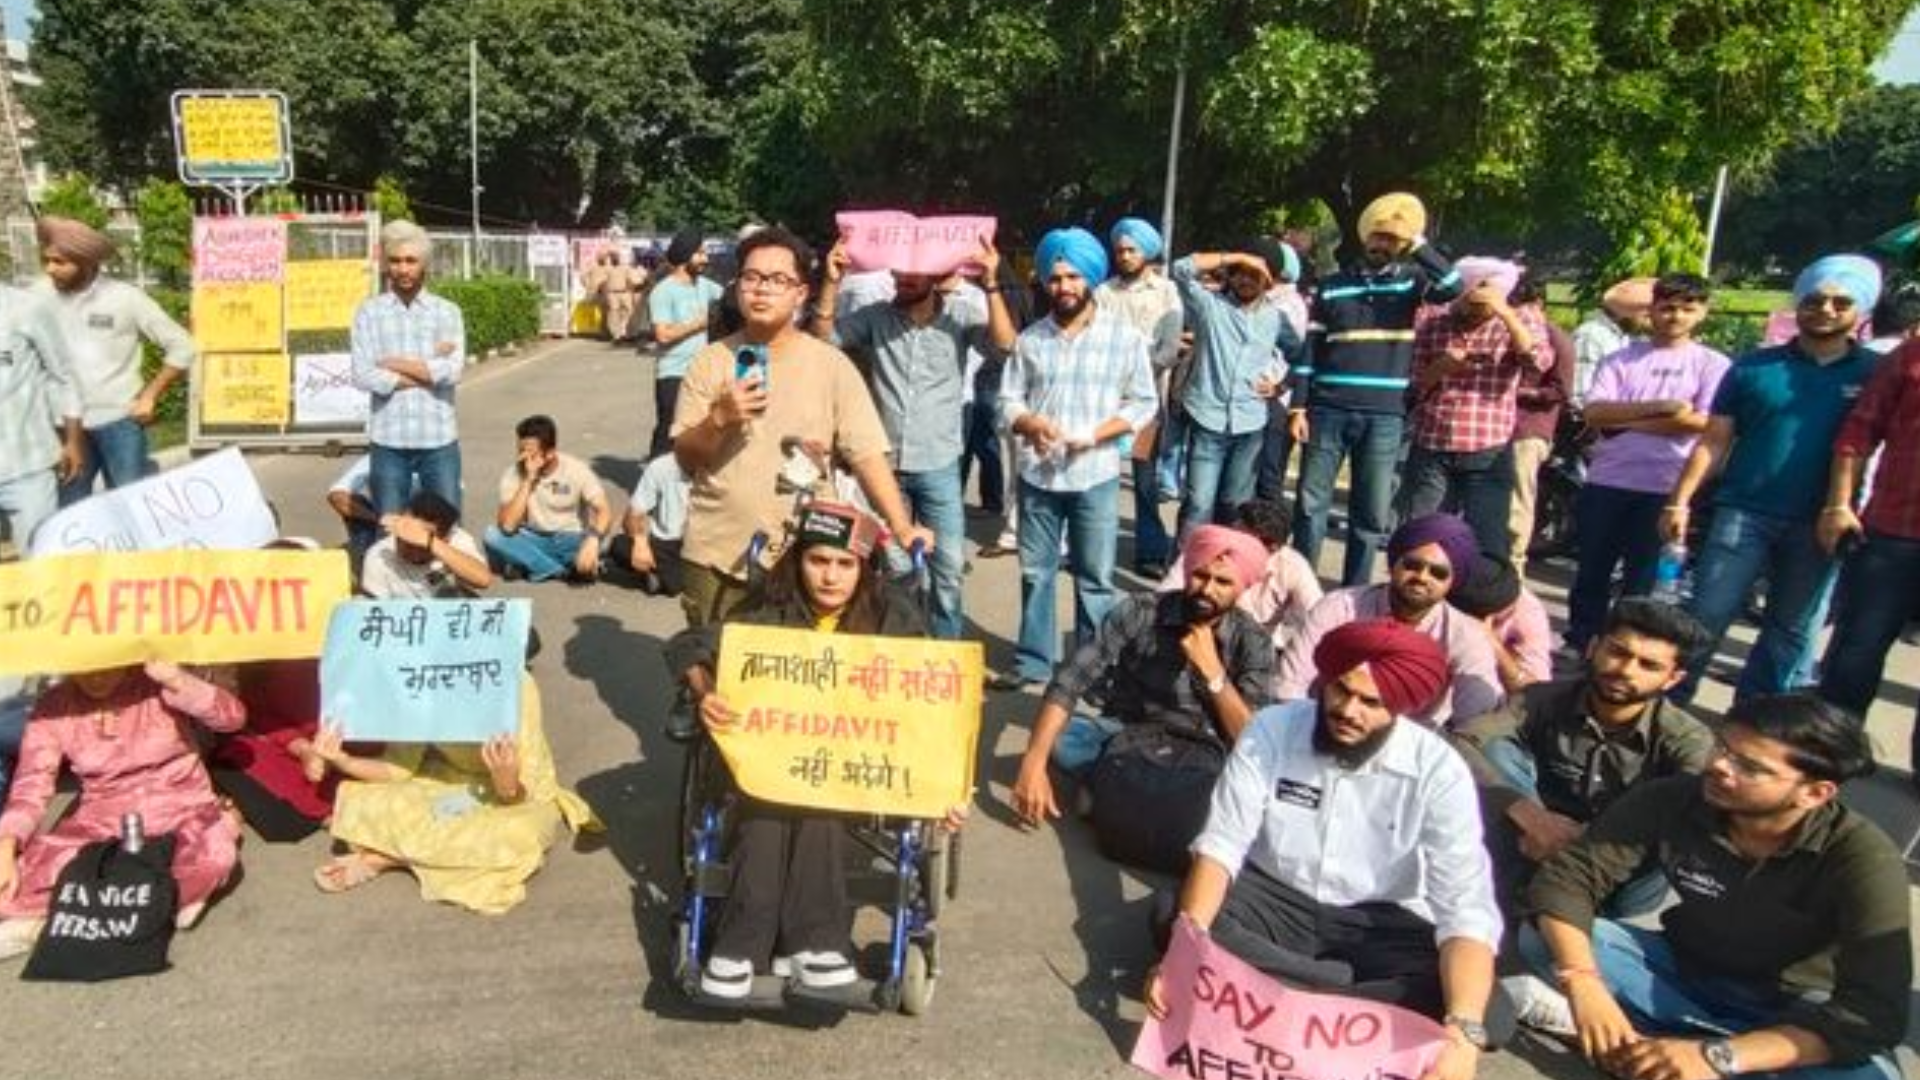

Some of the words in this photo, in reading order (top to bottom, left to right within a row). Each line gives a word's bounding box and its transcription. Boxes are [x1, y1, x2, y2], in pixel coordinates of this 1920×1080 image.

[143, 477, 224, 538] NO
[3, 599, 42, 630] TO
[61, 576, 311, 636] AFFIDAVIT
[744, 706, 900, 746] AFFIDAVIT
[1193, 965, 1275, 1032] SAY
[1304, 1012, 1382, 1049] NO
[1244, 1036, 1294, 1072] TO
